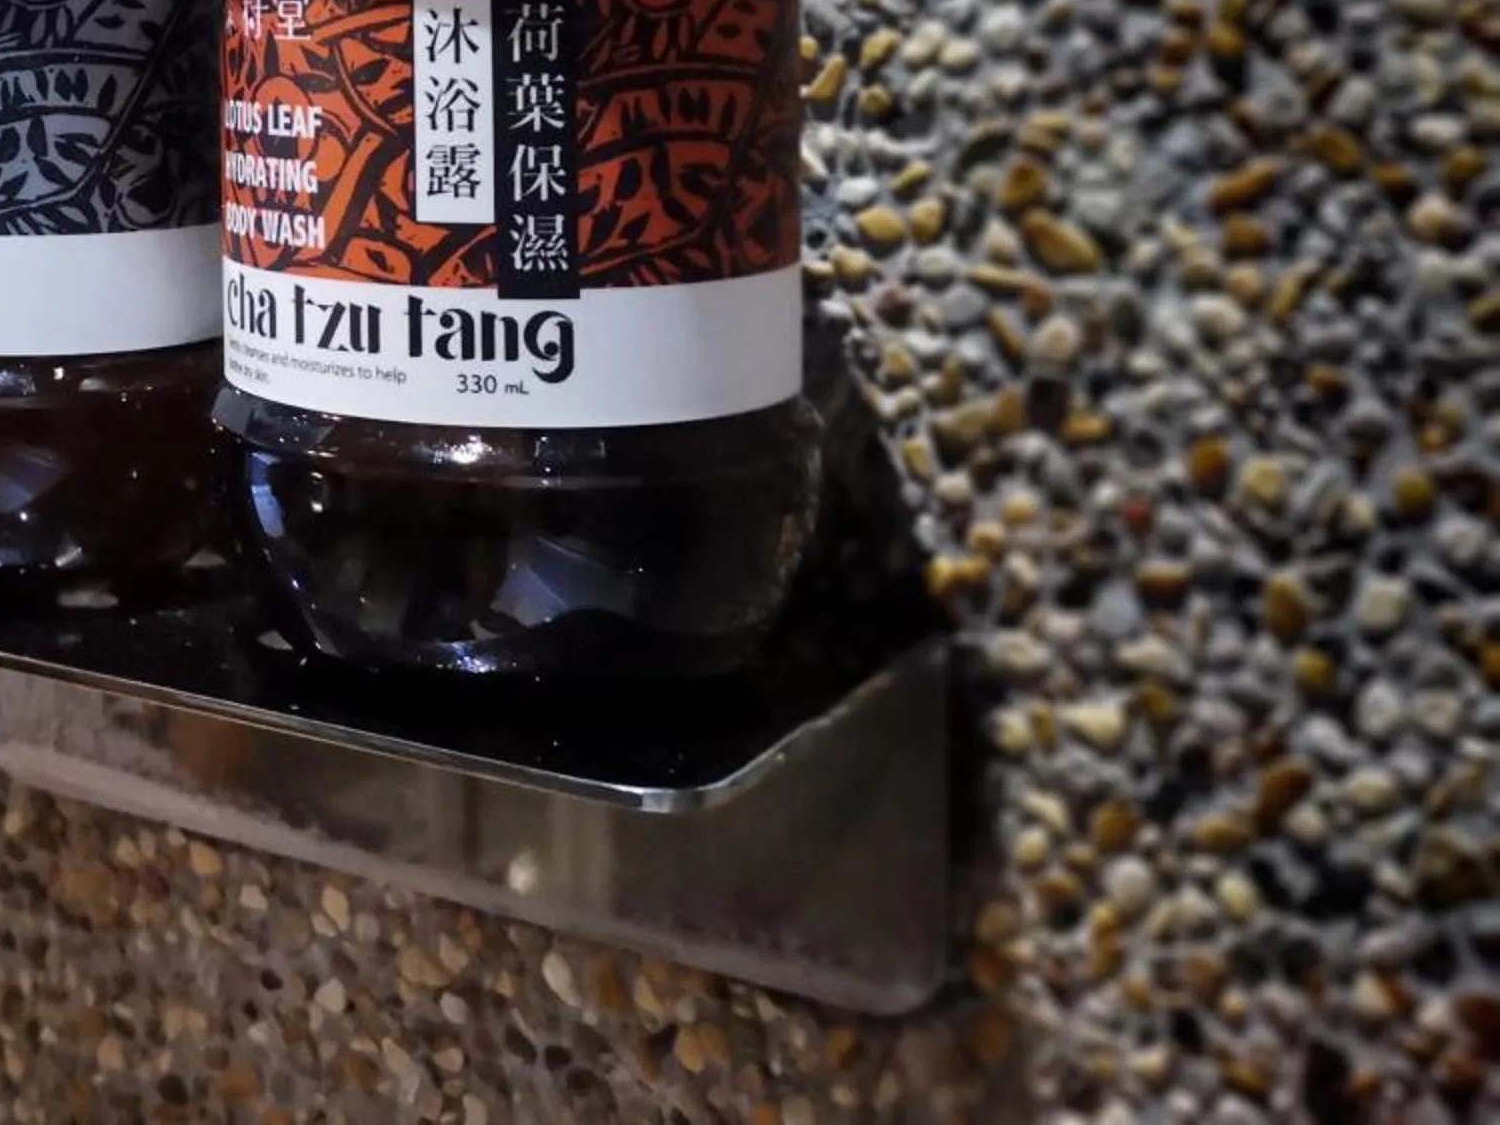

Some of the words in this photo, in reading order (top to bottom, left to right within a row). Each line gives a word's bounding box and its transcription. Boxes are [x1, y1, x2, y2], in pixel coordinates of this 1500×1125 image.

[267, 103, 322, 139] LEAF
[425, 7, 482, 200] 沐浴露
[505, 2, 570, 272] 荷葉保濕
[226, 151, 318, 194] HYDRATING
[226, 202, 257, 238] BODY
[261, 209, 325, 249] WASH
[227, 273, 277, 339] cha
[292, 284, 382, 354] tzu
[404, 295, 574, 383] tang
[357, 365, 373, 380] to
[375, 366, 407, 384] help
[456, 374, 497, 394] 330
[505, 380, 529, 394] mL
